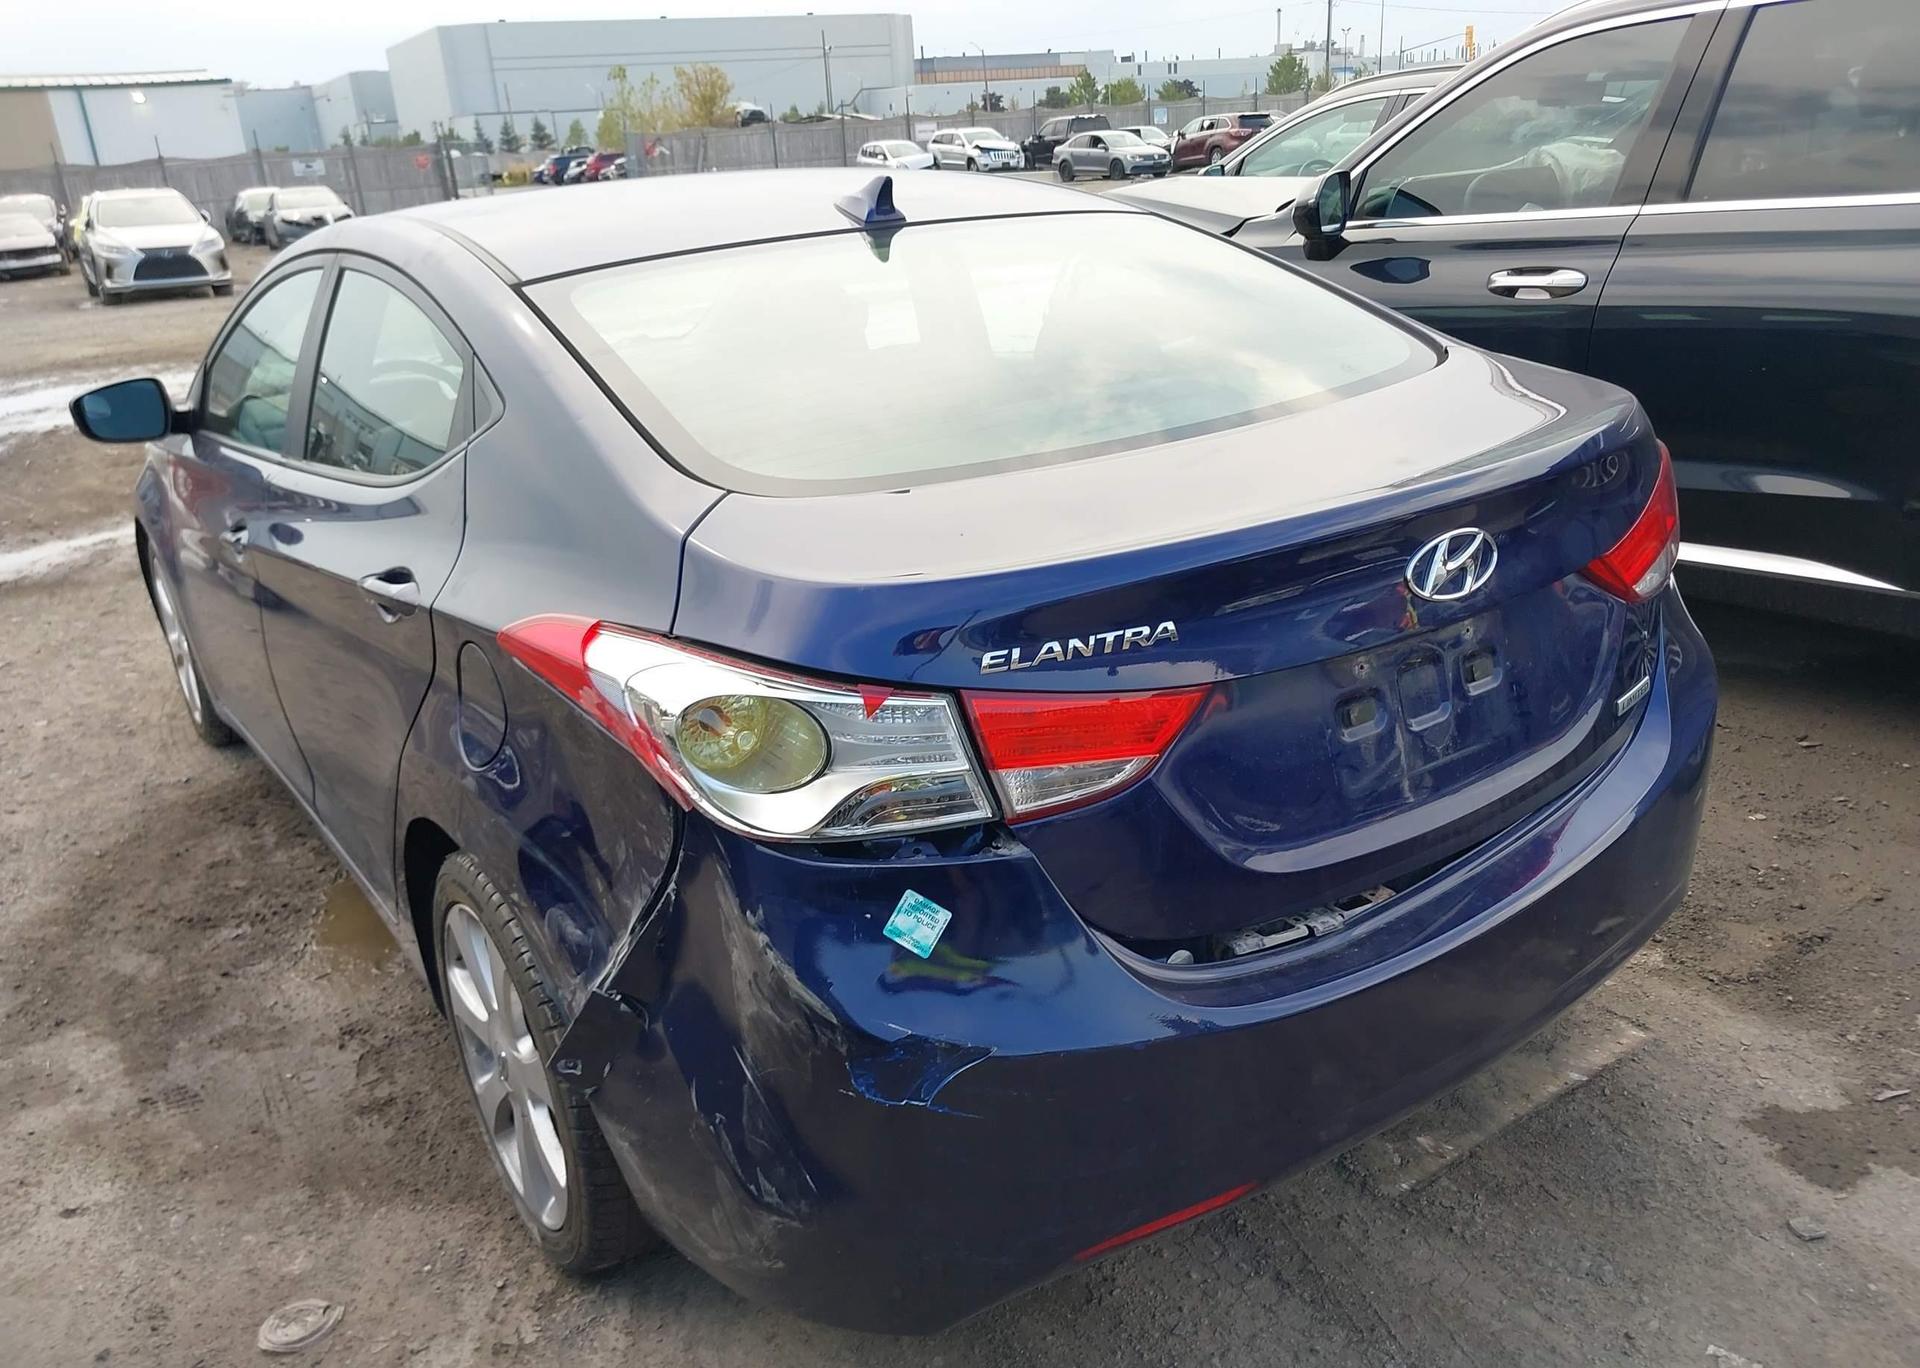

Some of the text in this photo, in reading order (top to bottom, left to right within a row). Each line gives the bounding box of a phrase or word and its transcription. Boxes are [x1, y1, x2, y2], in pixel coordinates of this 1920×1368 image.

[980, 620, 1178, 674] ELANTRA
[907, 902, 940, 924] REPORTED
[913, 897, 941, 915] DAMAGE
[903, 908, 912, 918] TO
[913, 914, 936, 931] POLICE
